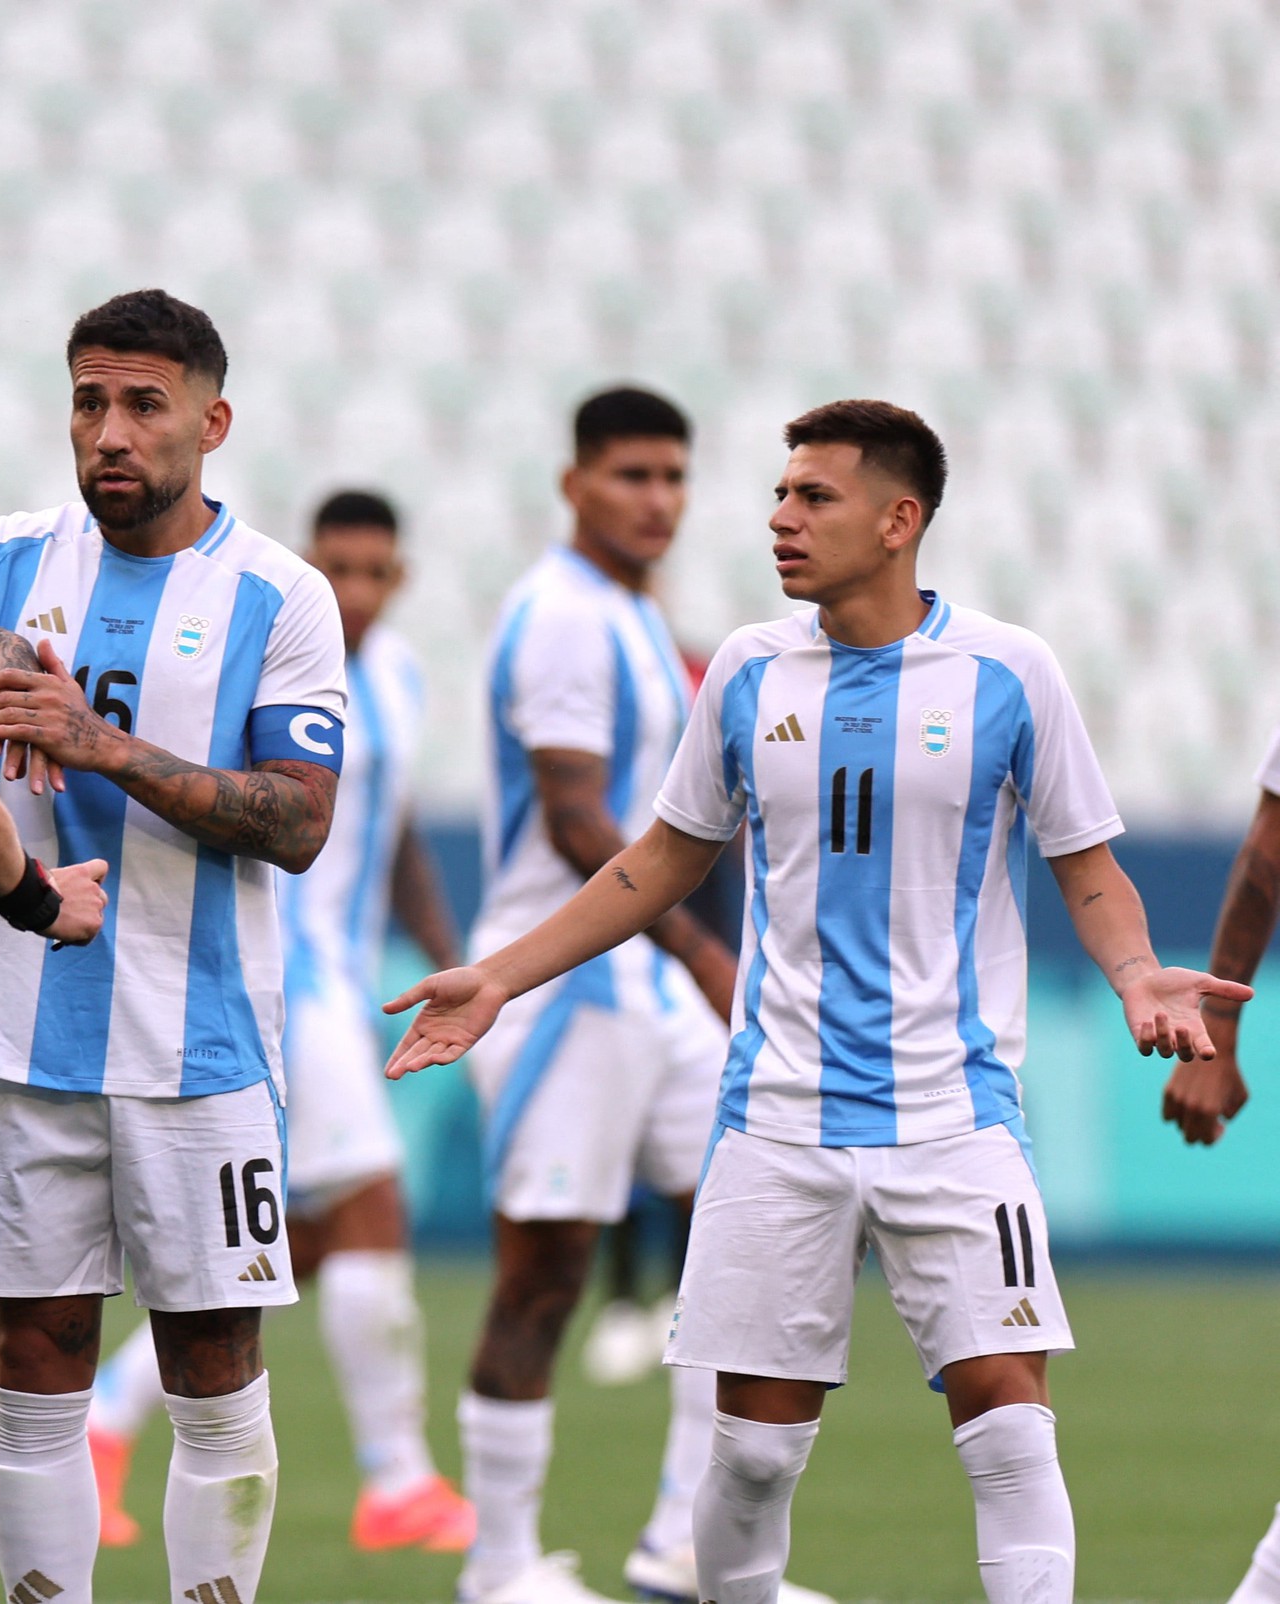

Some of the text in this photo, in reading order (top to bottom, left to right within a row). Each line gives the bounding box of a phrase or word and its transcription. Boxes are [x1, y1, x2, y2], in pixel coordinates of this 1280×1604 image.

[289, 712, 335, 755] C
[830, 766, 874, 855] 11
[219, 1157, 280, 1248] 16
[995, 1202, 1036, 1289] 11
